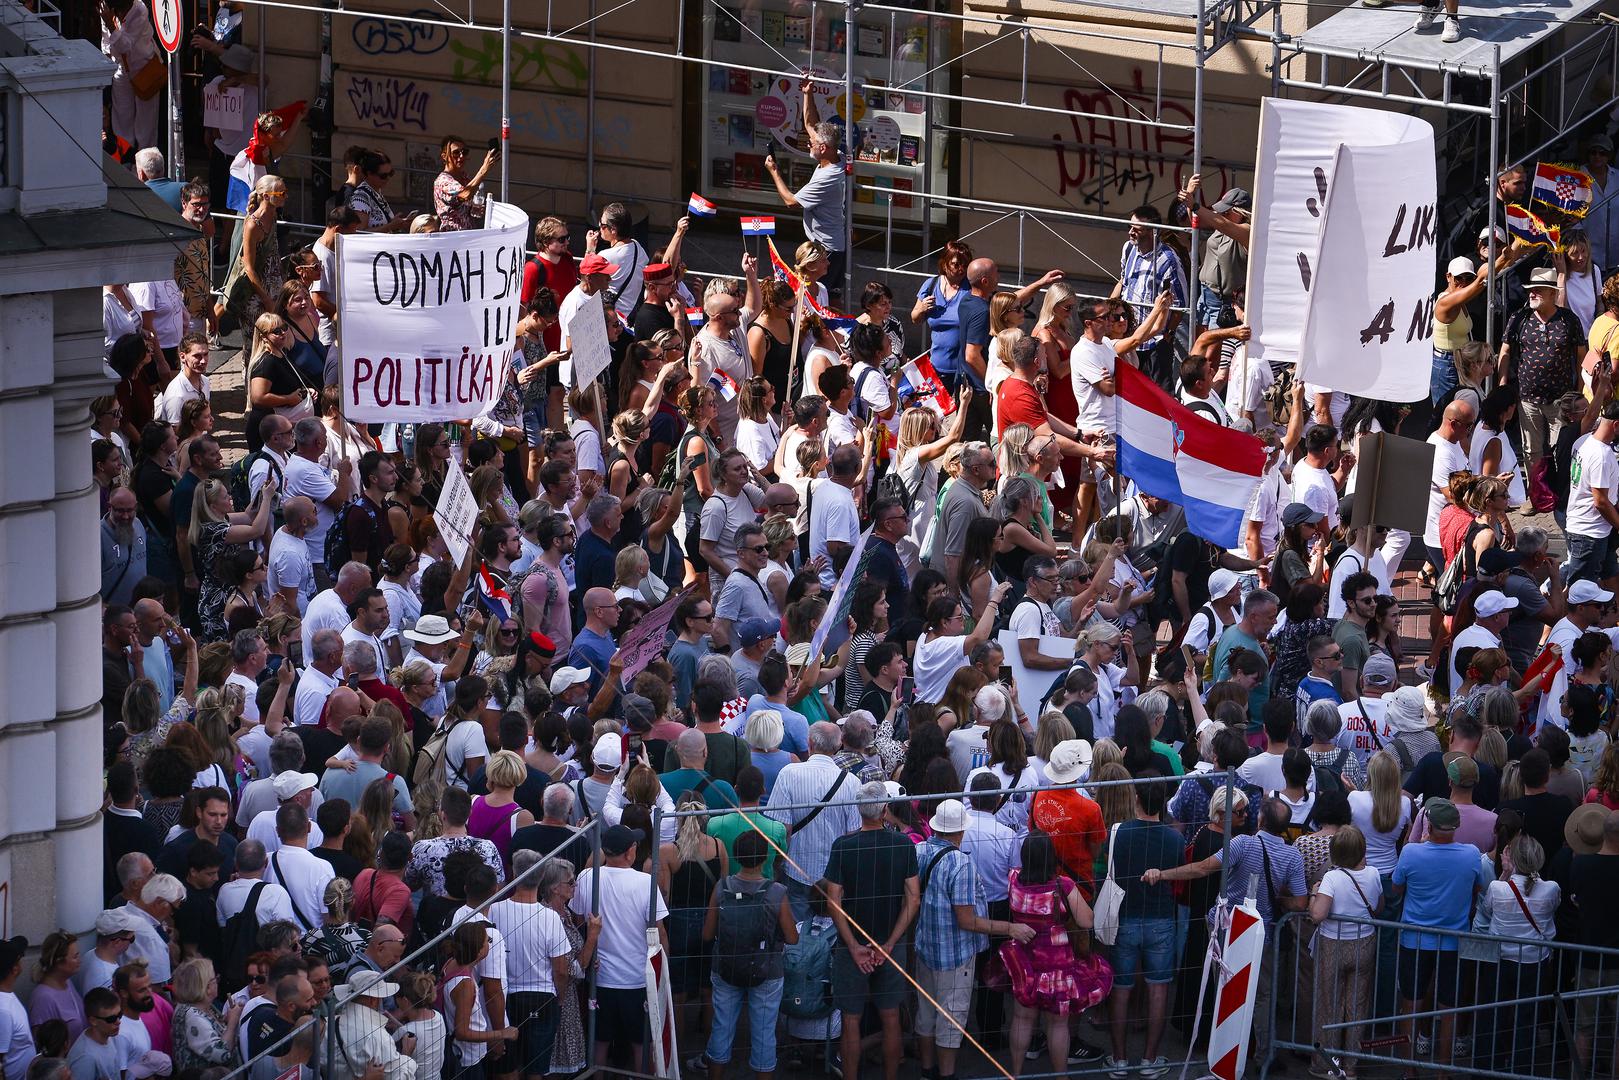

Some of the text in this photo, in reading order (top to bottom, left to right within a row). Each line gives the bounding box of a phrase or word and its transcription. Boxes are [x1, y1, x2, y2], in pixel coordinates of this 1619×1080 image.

[223, 95, 242, 114] TO!
[372, 251, 484, 308] ODMAH
[484, 306, 511, 347] ILI
[1360, 297, 1395, 346] A
[352, 346, 492, 407] POLITIČKA
[112, 543, 120, 558] 7
